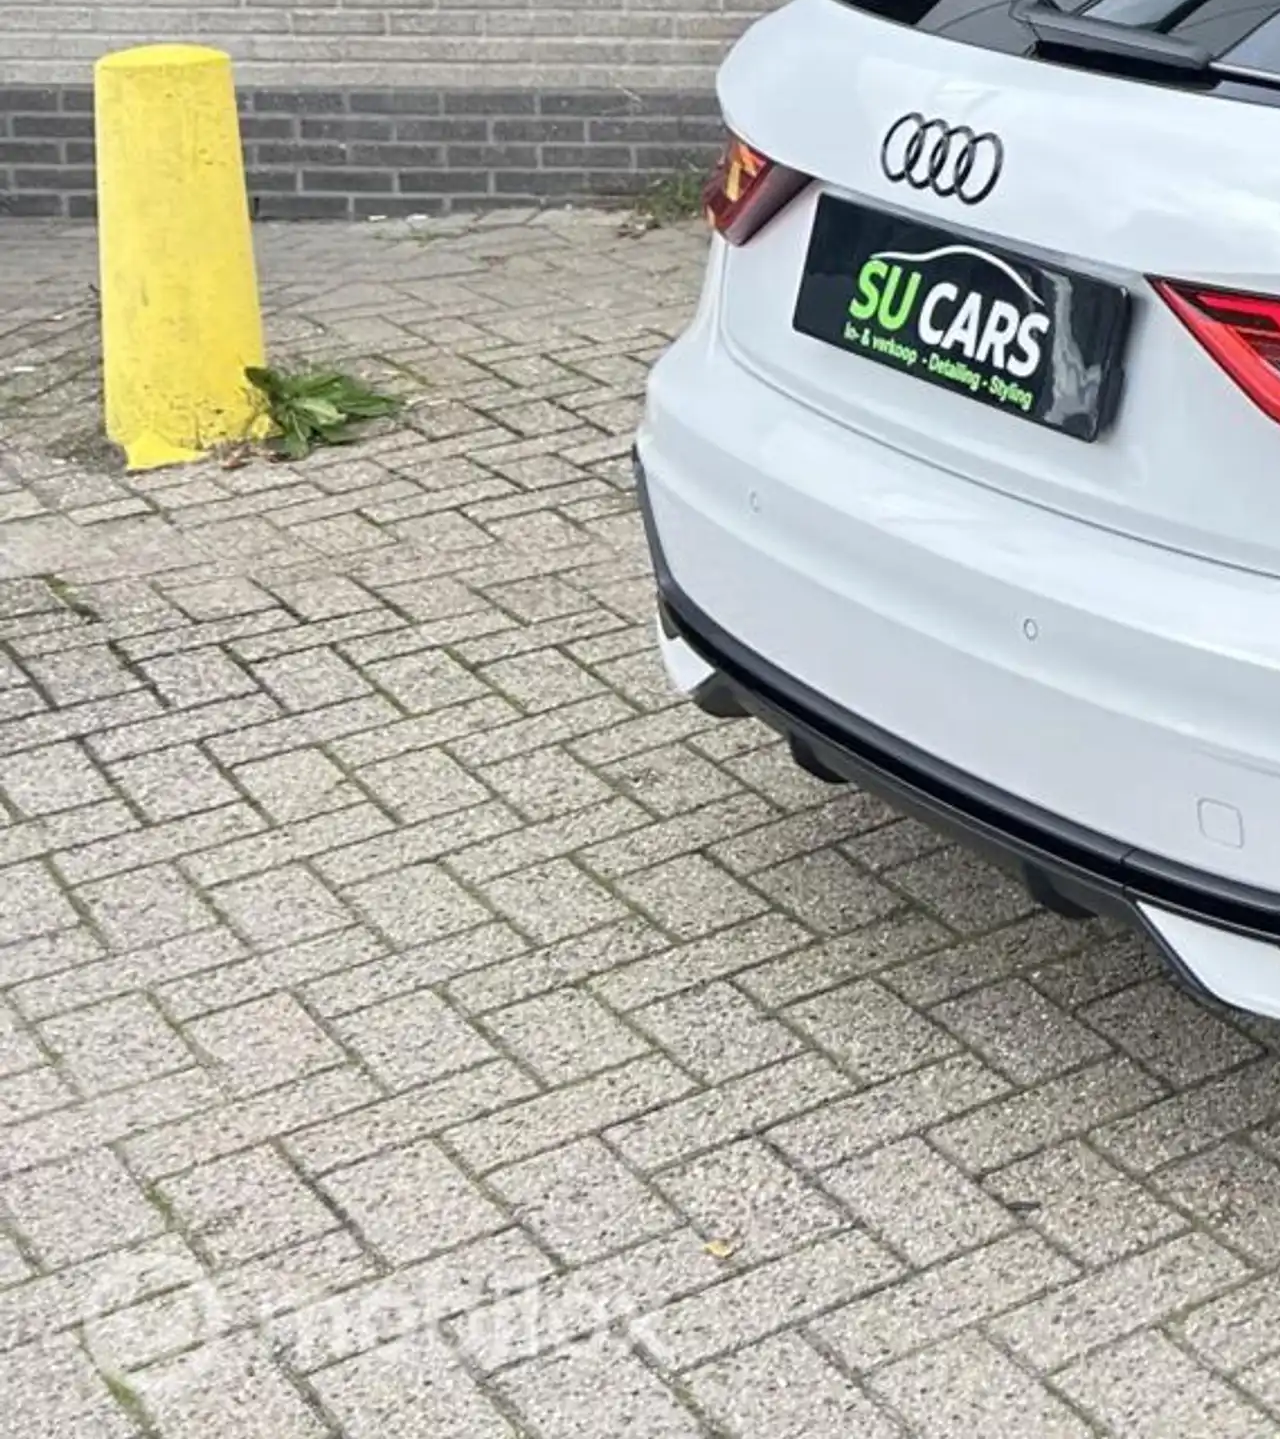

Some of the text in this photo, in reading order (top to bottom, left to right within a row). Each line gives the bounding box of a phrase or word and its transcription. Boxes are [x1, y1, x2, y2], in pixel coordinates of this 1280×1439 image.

[849, 260, 1050, 377] SU CARS
[861, 327, 871, 346] &
[872, 337, 917, 365] verkoop
[928, 352, 980, 391] Detailing
[989, 375, 1033, 410] Styling
